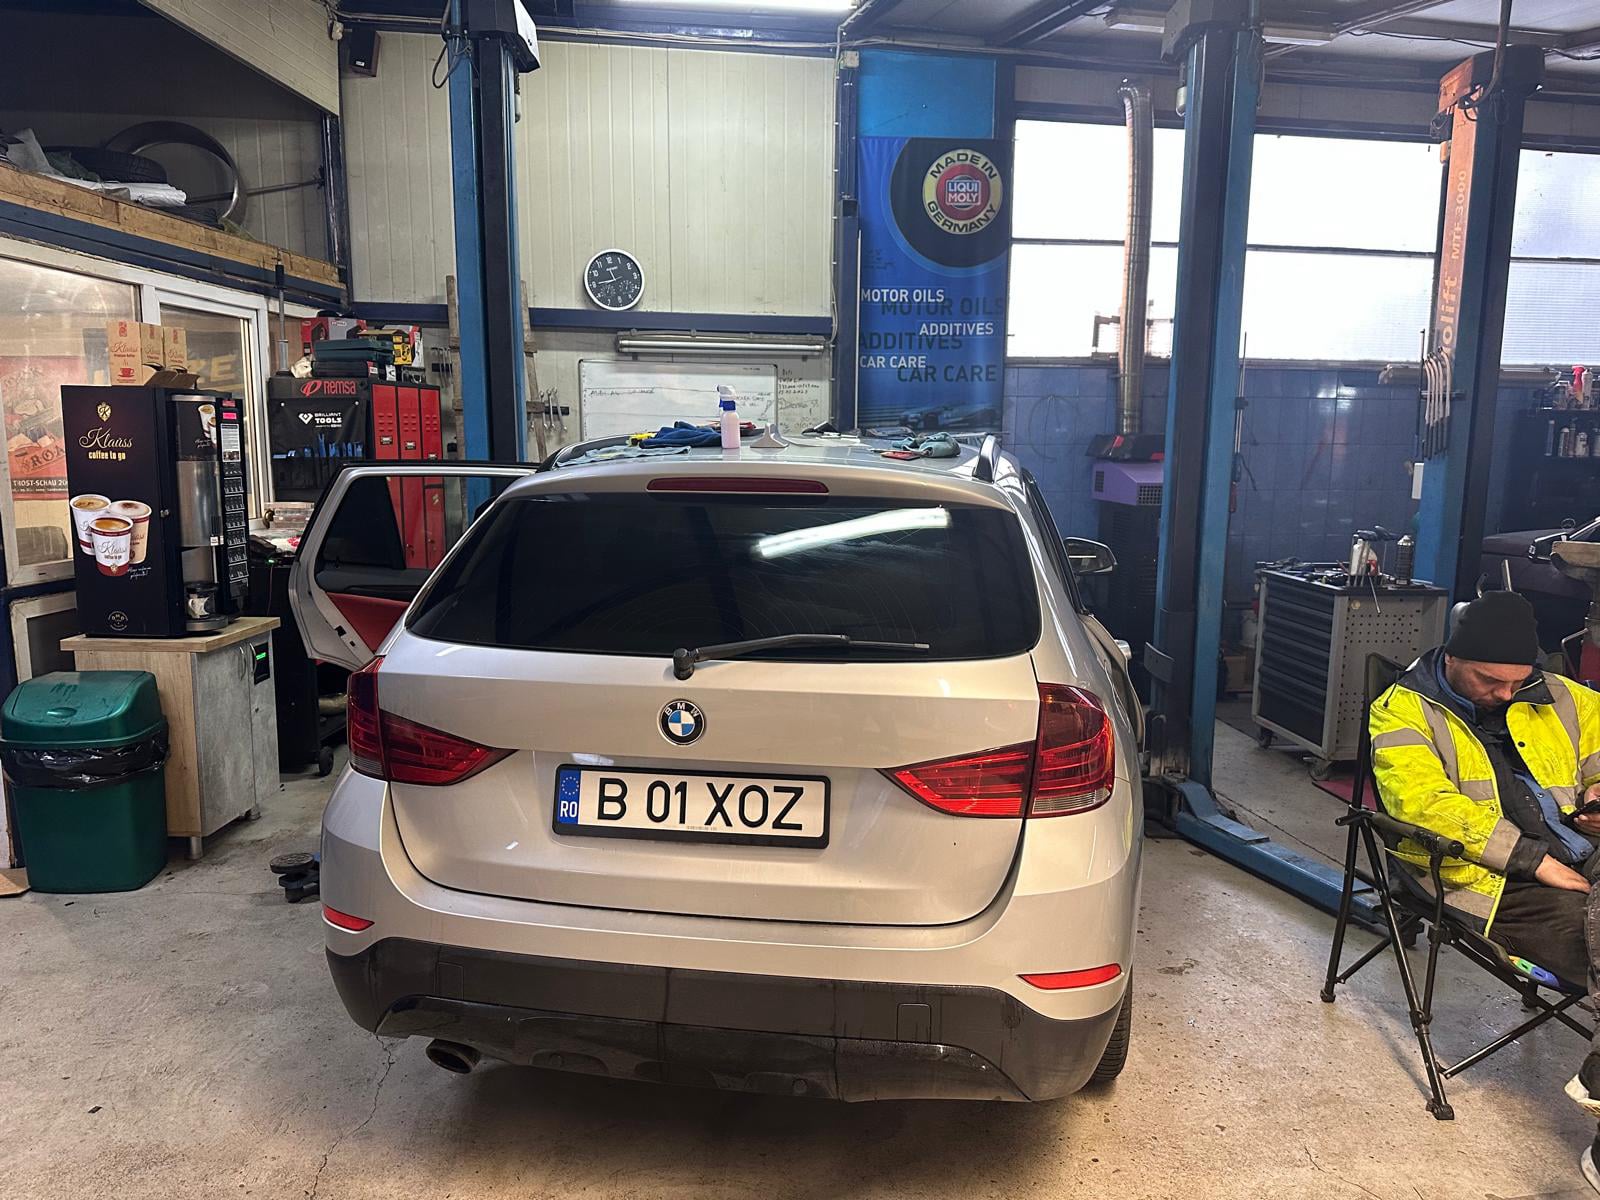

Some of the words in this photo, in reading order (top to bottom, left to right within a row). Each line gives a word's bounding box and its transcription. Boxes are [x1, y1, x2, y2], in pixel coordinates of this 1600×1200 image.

[930, 153, 981, 179] MADE
[981, 161, 997, 180] IN
[948, 182, 978, 193] LIQUI
[948, 192, 978, 203] MOLY
[927, 201, 996, 233] GERMANY
[1440, 275, 1459, 350] olift
[1455, 170, 1467, 216] 3000
[861, 289, 909, 302] MOTOR
[912, 289, 944, 302] OILS
[881, 298, 953, 316] MOTOR
[919, 323, 994, 336] ADDITIVES
[860, 332, 963, 350] ADDITIVES
[859, 356, 885, 368] CAR
[889, 356, 927, 368] CARE
[897, 365, 937, 383] CAR
[943, 365, 997, 382] CARE
[88, 449, 109, 460] coffee
[109, 450, 117, 460] to
[117, 452, 126, 462] go
[560, 800, 578, 818] RO
[597, 777, 628, 821] B
[646, 780, 688, 824] 01
[704, 782, 804, 831] XOZ
